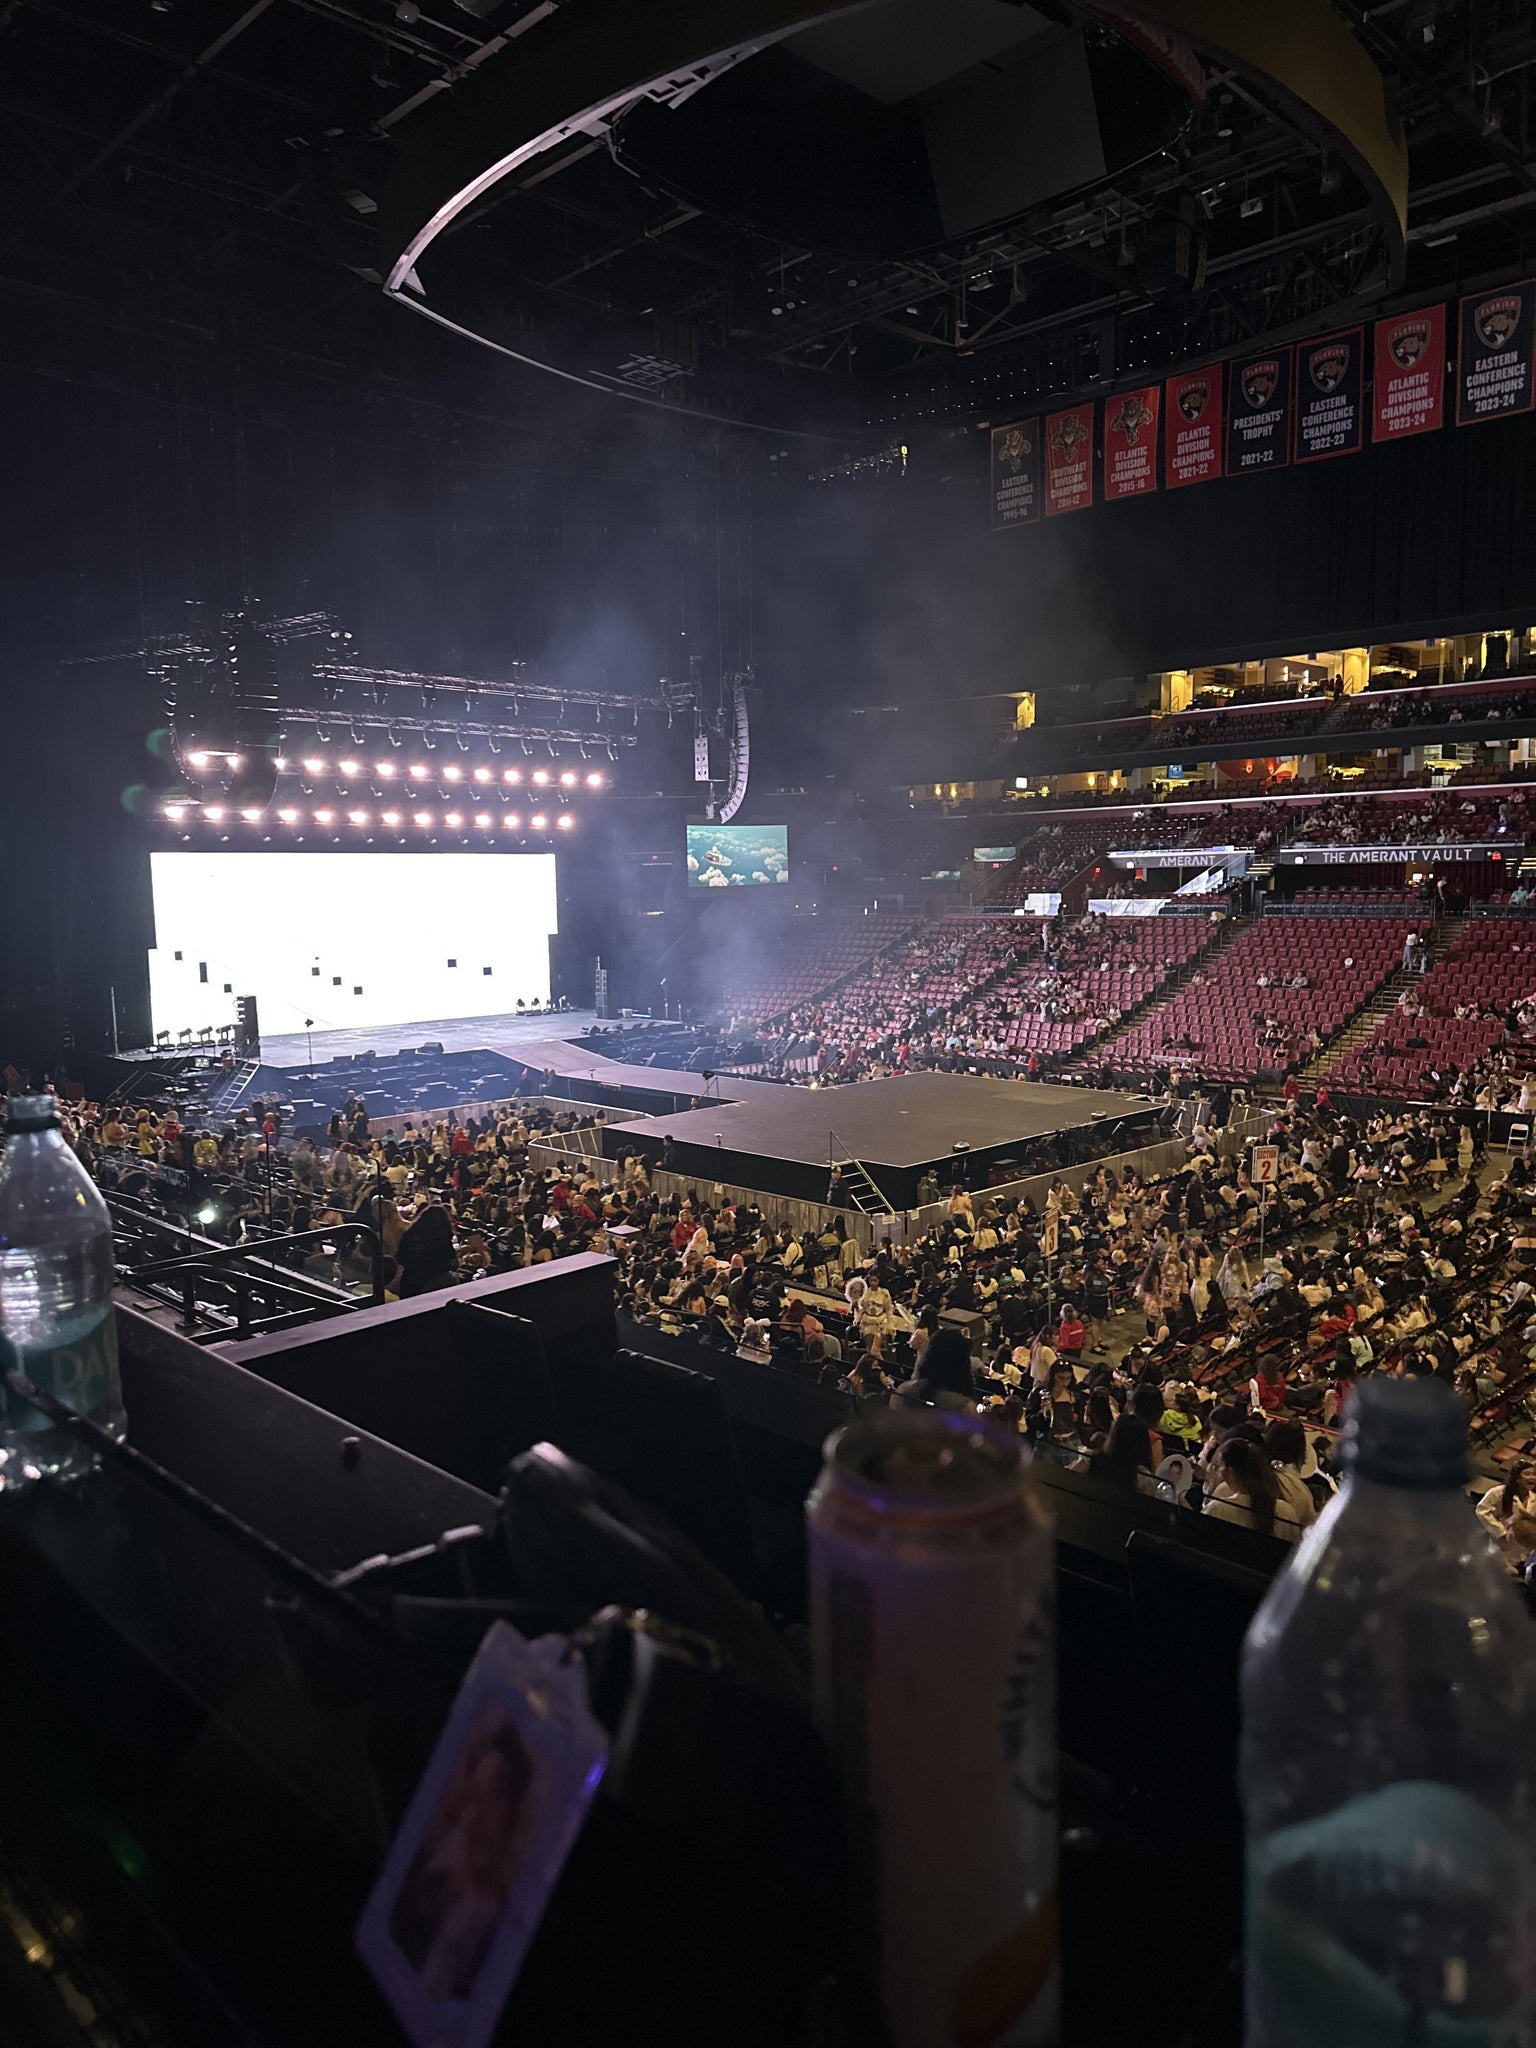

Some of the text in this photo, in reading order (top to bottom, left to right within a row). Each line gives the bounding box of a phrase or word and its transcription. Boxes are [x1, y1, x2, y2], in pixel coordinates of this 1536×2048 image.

[1475, 351, 1518, 372] EASTERN
[1388, 372, 1429, 392] ATLANTIC
[1466, 363, 1526, 388] CONFERENCE
[1388, 386, 1428, 405] DIVISION
[1467, 377, 1524, 400] CHAMPIONS
[1310, 394, 1346, 413] EASTERN
[1381, 398, 1434, 419] CHAMPIONS
[1475, 393, 1515, 413] 2023-24
[1302, 406, 1354, 427] CONFERENCE
[1388, 414, 1425, 431] 2023-24
[1177, 426, 1210, 443] ATLANTIC
[1243, 425, 1273, 440] TROPHY
[1303, 420, 1352, 439] CHAMPIONS
[1178, 438, 1210, 455] DIVISION
[1310, 434, 1344, 451] 2022-23
[1115, 446, 1148, 461] ATLANTIC
[1172, 450, 1214, 468] CHAMPIONS
[1241, 450, 1273, 466] 2021-22
[1050, 461, 1087, 479] SOUTHEAST
[1116, 456, 1146, 471] DIVISION
[1179, 463, 1208, 479] 2021-22
[1002, 474, 1028, 488] EASTERN
[1055, 473, 1082, 487] DIVISION
[1111, 466, 1150, 482] CHAMPIONS
[997, 483, 1034, 500] CONFERENCE
[1050, 482, 1087, 499] CHAMPIONS
[1119, 479, 1145, 492] 2015-16
[998, 495, 1033, 510] CHAMPIONS
[1159, 856, 1215, 866] AMERANT
[1323, 849, 1472, 863] THE AMERANT VAULT
[1257, 1150, 1276, 1159] SECTION
[1261, 1160, 1271, 1180] 2
[1049, 1227, 1055, 1251] 3
